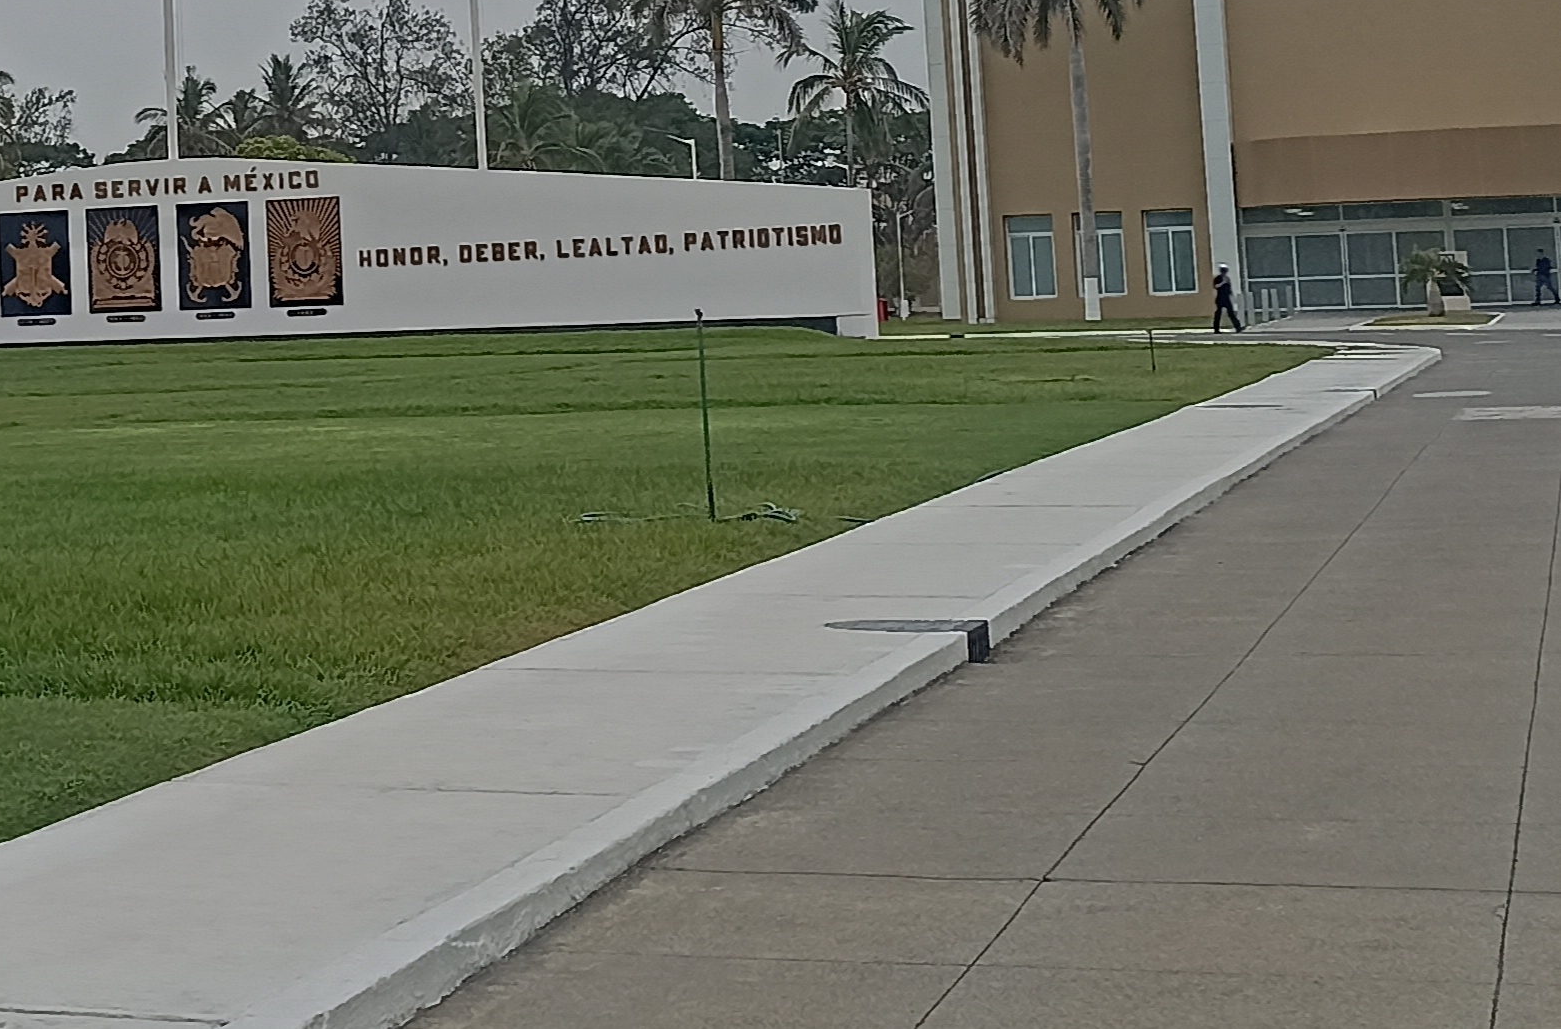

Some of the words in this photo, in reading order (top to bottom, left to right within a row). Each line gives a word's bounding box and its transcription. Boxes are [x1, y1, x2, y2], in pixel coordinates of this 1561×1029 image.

[15, 182, 84, 204] PARA
[94, 176, 187, 200] SERVIR
[197, 175, 213, 195] A
[222, 166, 320, 193] MÉXICO
[358, 245, 449, 268] HONOR,
[458, 240, 546, 264] DEBER,
[555, 233, 675, 259] LEALTAD,
[683, 223, 843, 253] PATRIOTISMO
